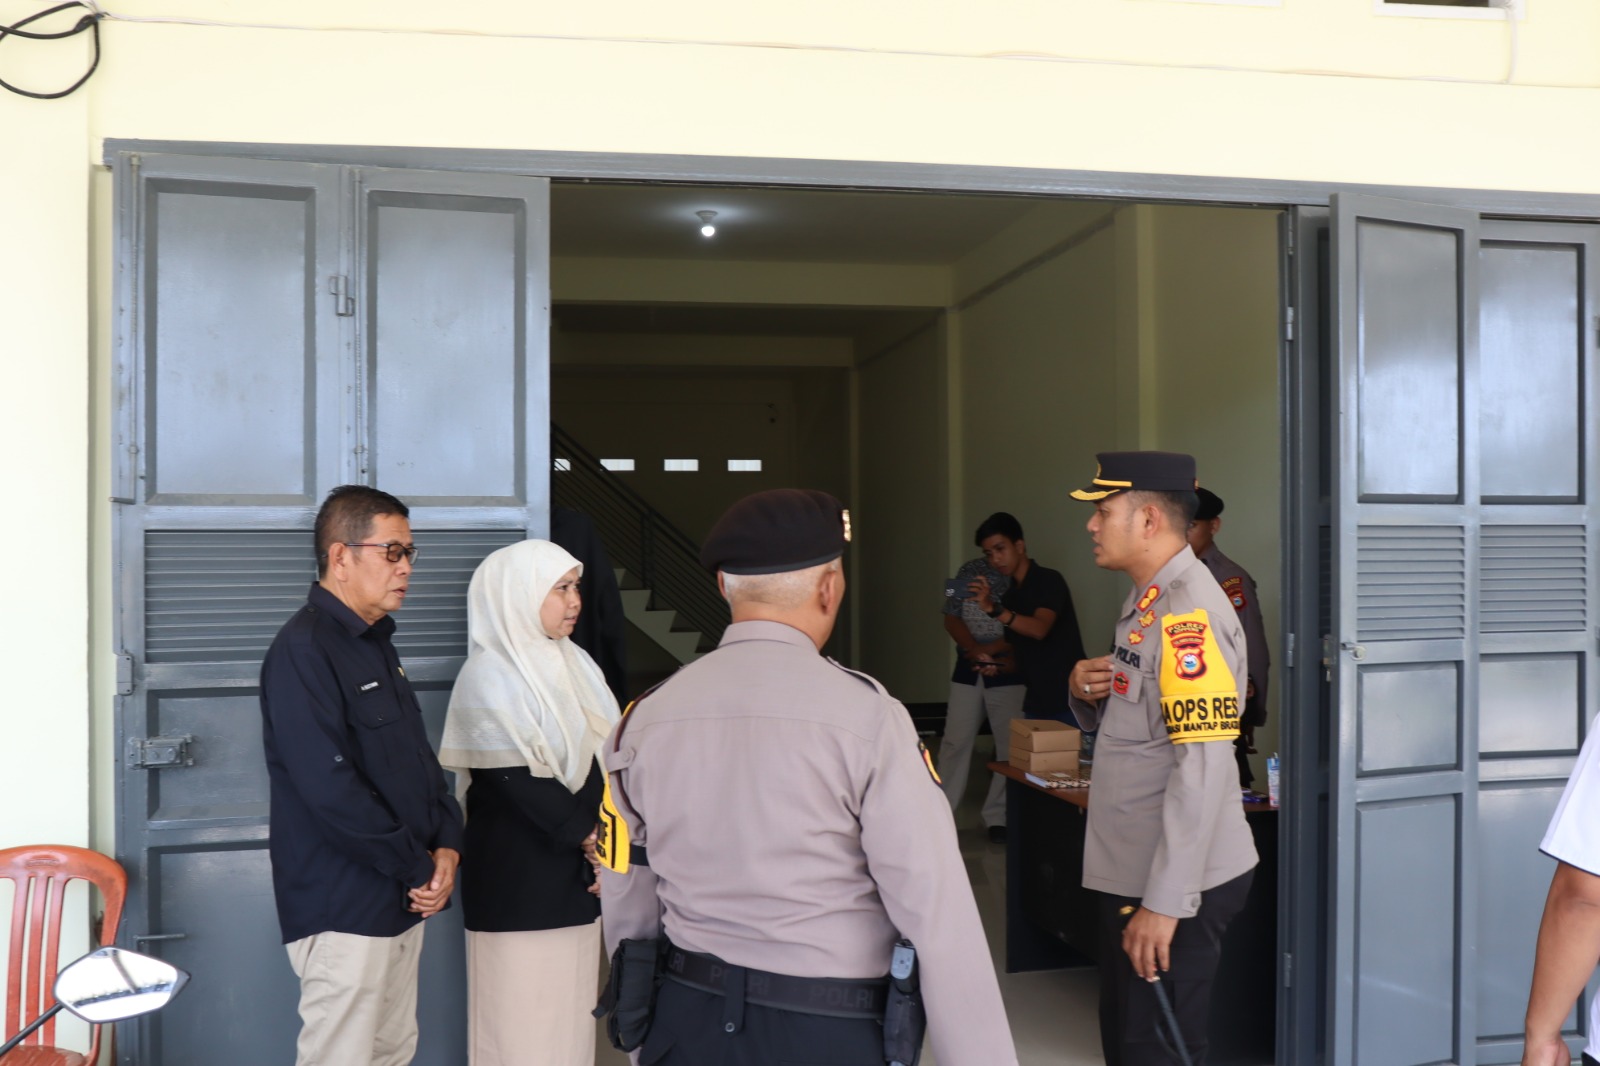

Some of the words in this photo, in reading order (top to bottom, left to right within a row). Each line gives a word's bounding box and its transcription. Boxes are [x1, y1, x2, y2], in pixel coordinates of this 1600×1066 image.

[1115, 646, 1140, 669] POLRI
[1173, 698, 1208, 722] OPS
[1213, 697, 1238, 719] RES
[1184, 721, 1218, 731] MANTAP
[808, 985, 875, 1010] POLRI
